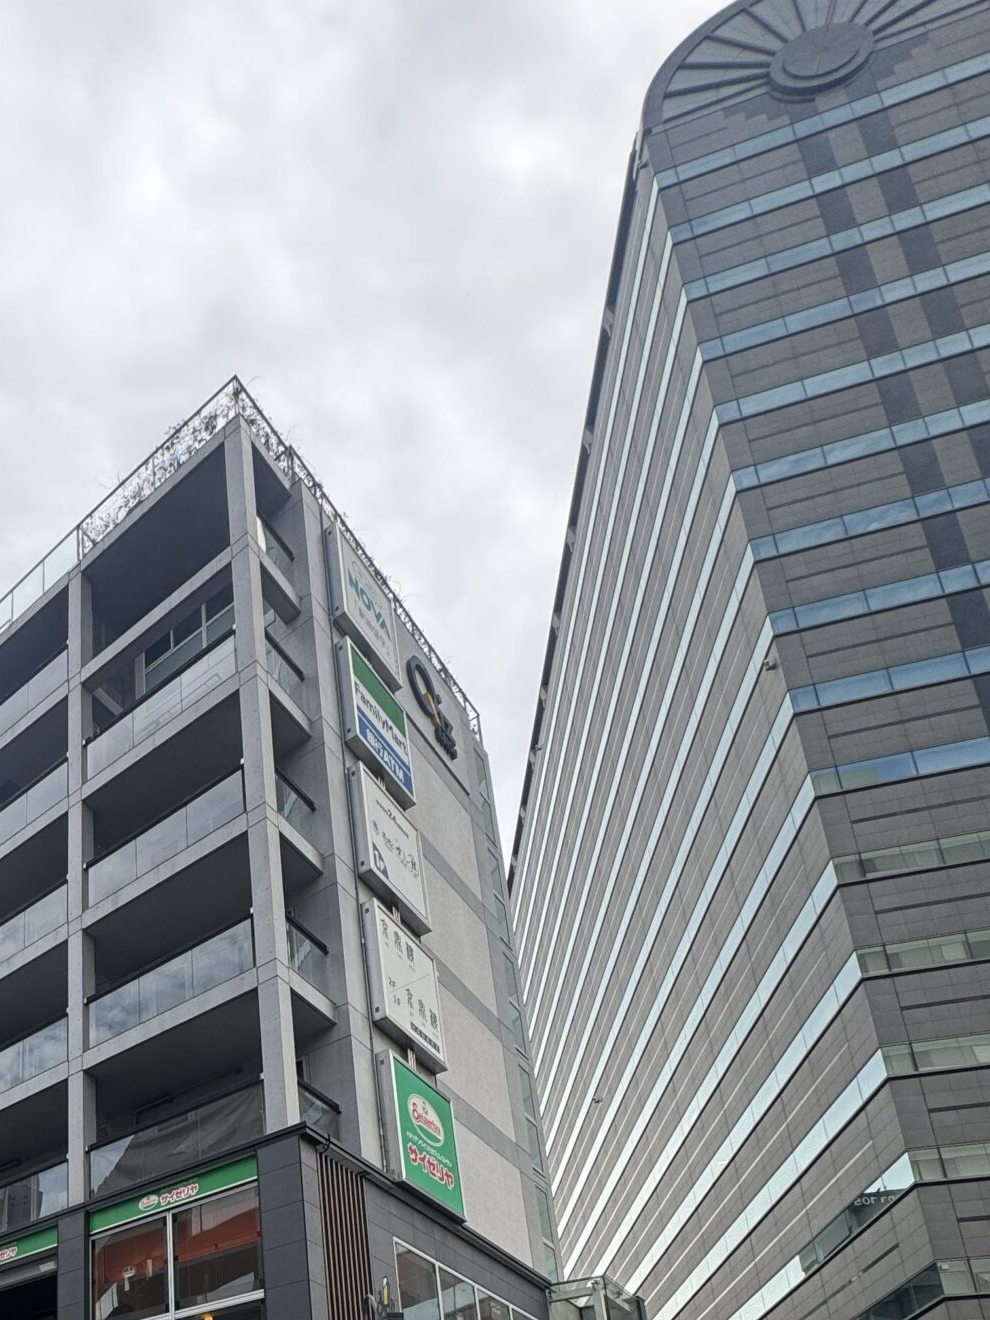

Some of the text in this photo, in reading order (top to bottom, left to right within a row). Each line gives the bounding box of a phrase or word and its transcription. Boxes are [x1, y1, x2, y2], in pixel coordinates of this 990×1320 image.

[347, 568, 392, 641] NOVA
[354, 681, 409, 756] FamilyMart
[160, 1183, 199, 1206] サイゼリヤ
[408, 1143, 454, 1190] サイゼリヤ
